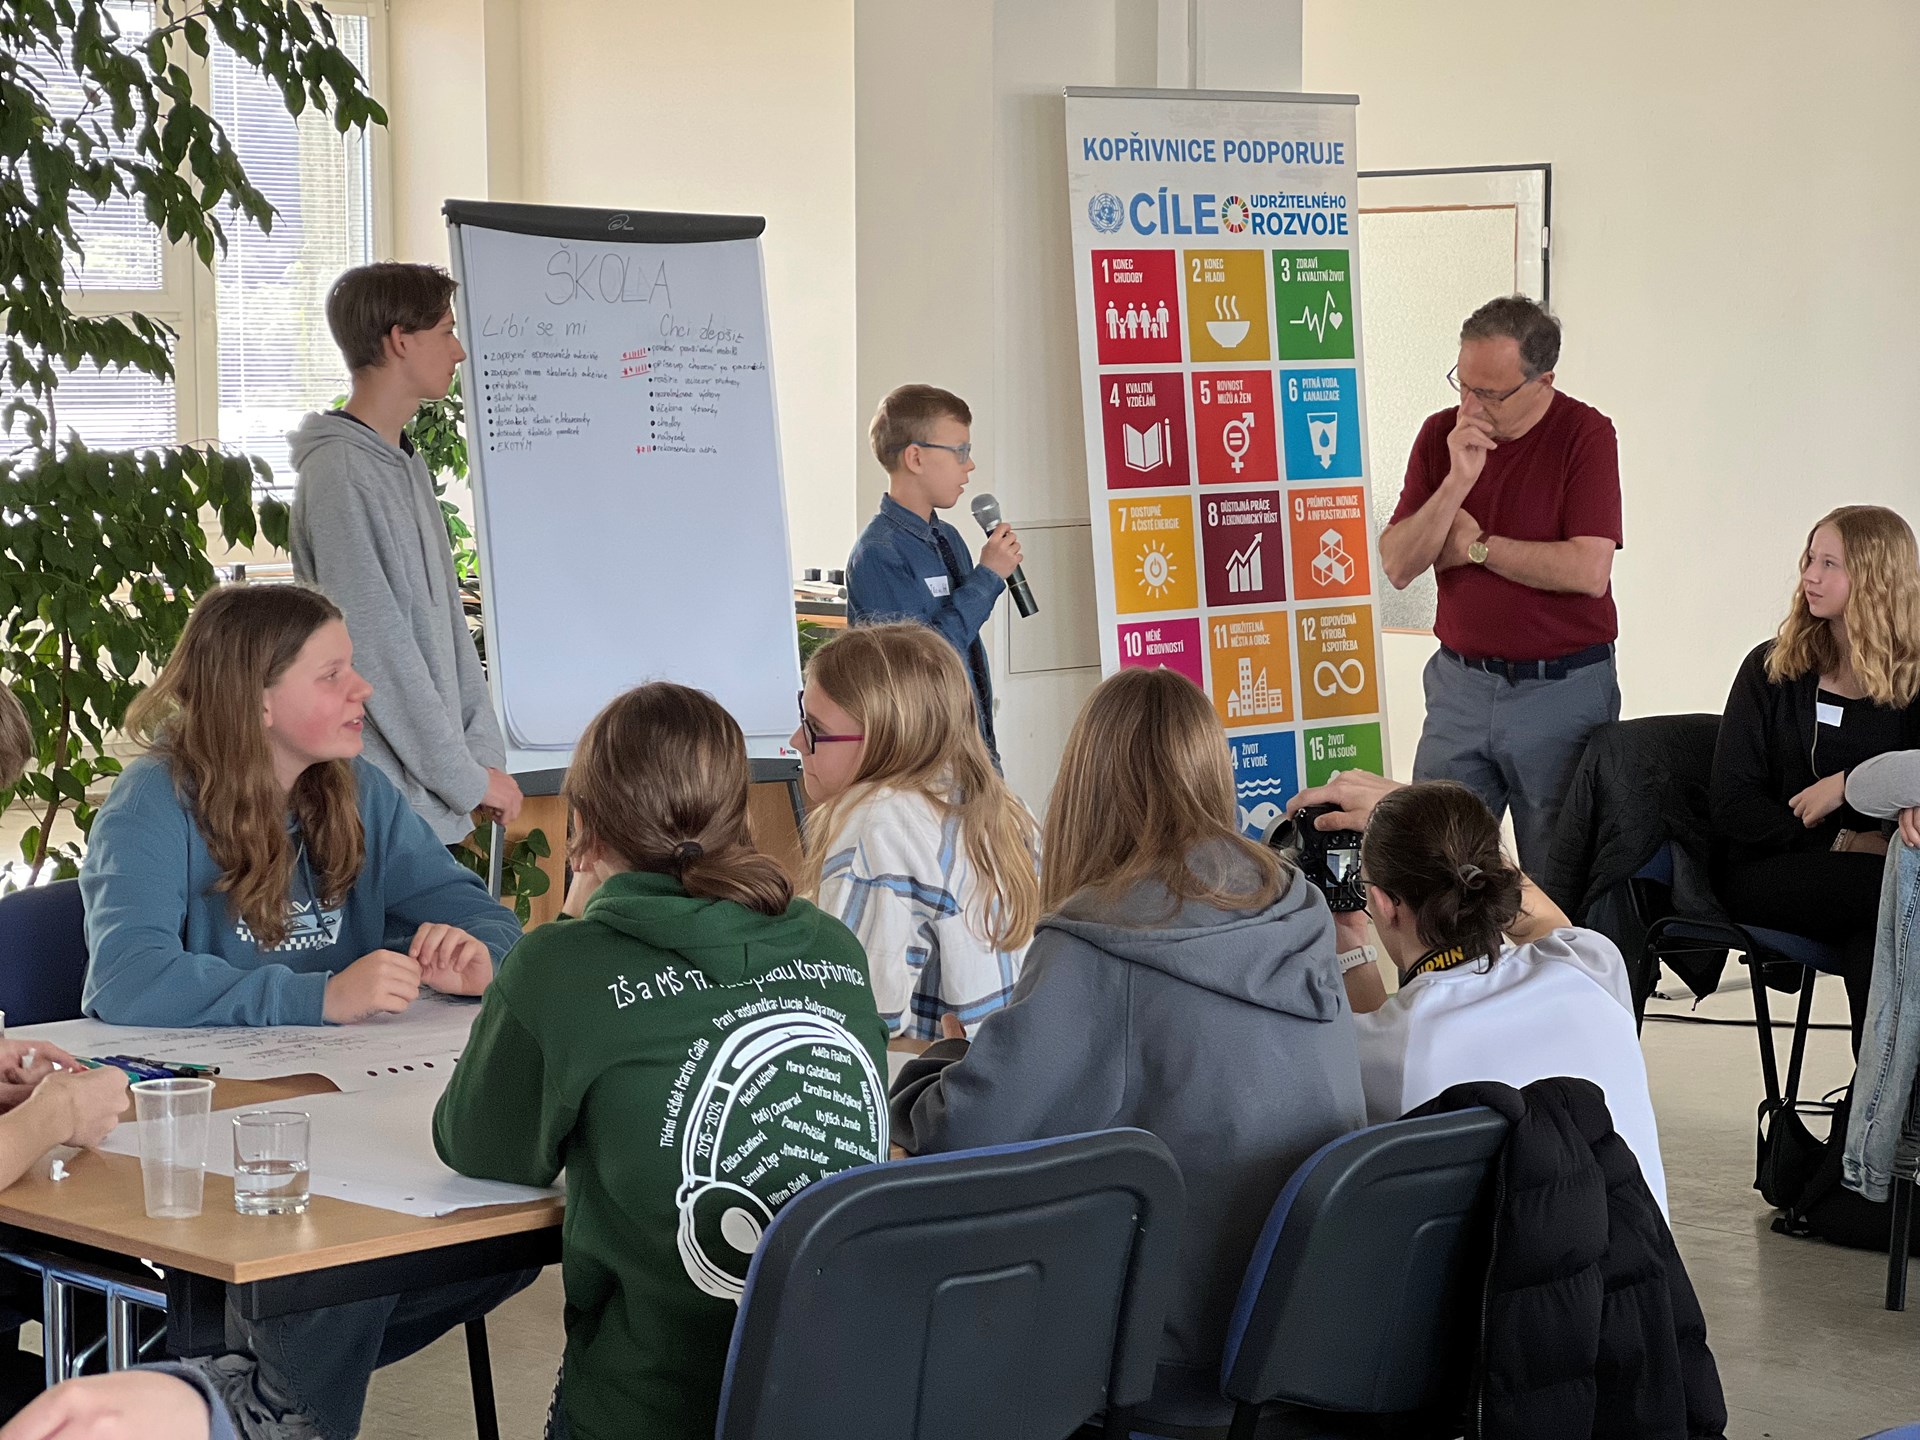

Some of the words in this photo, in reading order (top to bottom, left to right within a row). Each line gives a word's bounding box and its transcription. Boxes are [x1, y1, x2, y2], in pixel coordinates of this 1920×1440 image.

[1083, 131, 1216, 163] KOPŘIVNICE
[1223, 140, 1345, 165] PODPORUJE
[1250, 191, 1347, 209] UDRŽITELNÉHO
[1129, 186, 1219, 236] CÍLE
[1251, 212, 1349, 236] ROZVOJE
[1101, 258, 1110, 284] 1
[1112, 258, 1134, 270] KONEC
[1191, 258, 1202, 283] 2
[1204, 258, 1224, 270] KONEC
[1281, 257, 1291, 282] 3
[1296, 256, 1319, 269] ZDRAVÍ
[545, 242, 672, 309] ŠKOLA
[1113, 271, 1144, 284] CHUDOBY
[1204, 271, 1225, 283] HLADU
[1296, 270, 1302, 282] A
[1303, 269, 1328, 282] KVALITNÍ
[1328, 269, 1345, 282] ŽIVOT
[536, 322, 555, 337] se
[566, 319, 588, 336] mi
[660, 313, 692, 338] Chci
[1125, 380, 1153, 395] KVALITNÍ
[1217, 380, 1244, 391] ROVNOST
[1288, 378, 1298, 402] 6
[1302, 376, 1320, 389] PITNÁ
[1109, 382, 1120, 408] 4
[1126, 393, 1156, 408] VZDĚLÁNÍ
[1200, 380, 1211, 405] 5
[1217, 390, 1234, 404] MUŽŮ
[1234, 392, 1239, 404] A
[1239, 390, 1252, 404] ŽEN
[1303, 390, 1340, 402] KANALIZACE
[1220, 499, 1250, 512] DŮSTOJNÁ
[1250, 498, 1270, 511] PRÁCE
[1335, 494, 1358, 506] INOVACE
[1130, 504, 1162, 518] DOSTUPNÉ
[1207, 502, 1219, 527] 8
[1222, 514, 1227, 526] A
[1227, 511, 1264, 526] EKONOMICKÝ
[1264, 510, 1278, 524] RŮST
[1294, 497, 1305, 522] 9
[1307, 509, 1313, 521] A
[1313, 507, 1361, 521] INFRASTRUKTURA
[1118, 507, 1127, 532] 7
[1132, 519, 1137, 531] A
[1137, 517, 1154, 531] ČISTÉ
[1154, 517, 1179, 530] ENERGIE
[1230, 620, 1264, 634] UDRŽITELNÁ
[1320, 612, 1357, 627] ODPOVĚDNÁ
[1145, 628, 1161, 642] MÉNĚ
[1214, 624, 1228, 649] 11
[1302, 617, 1316, 641] 12
[1321, 625, 1346, 640] VÝROBA
[1124, 631, 1142, 658] 10
[1146, 639, 1184, 656] NEROVNOSTÍ
[1231, 633, 1249, 647] MĚSTA
[1249, 635, 1254, 646] A
[1254, 633, 1270, 646] OBCE
[1322, 641, 1327, 653] A
[1327, 638, 1358, 652] SPOTŘEBA
[1328, 732, 1345, 746] ŽIVOT
[1242, 742, 1259, 756] ŽIVOT
[1309, 736, 1324, 761] 15
[1328, 747, 1336, 759] NA
[1336, 745, 1357, 758] SOUŠI
[1230, 745, 1239, 771] 4
[1242, 756, 1250, 768] VE
[1250, 753, 1268, 767] VODĚ
[793, 959, 865, 989] Kopřivnice
[608, 975, 636, 1009] ZŠ
[636, 981, 653, 999] a
[655, 966, 684, 997] MŠ
[685, 970, 713, 990] 17.
[712, 1009, 736, 1031] Paní
[778, 995, 803, 1011] Lucie
[738, 1083, 761, 1107] Michal
[659, 1117, 677, 1148] Třídní
[674, 1060, 697, 1091] Martin
[781, 1114, 802, 1133] Pavel
[741, 1161, 768, 1187] Samuel
